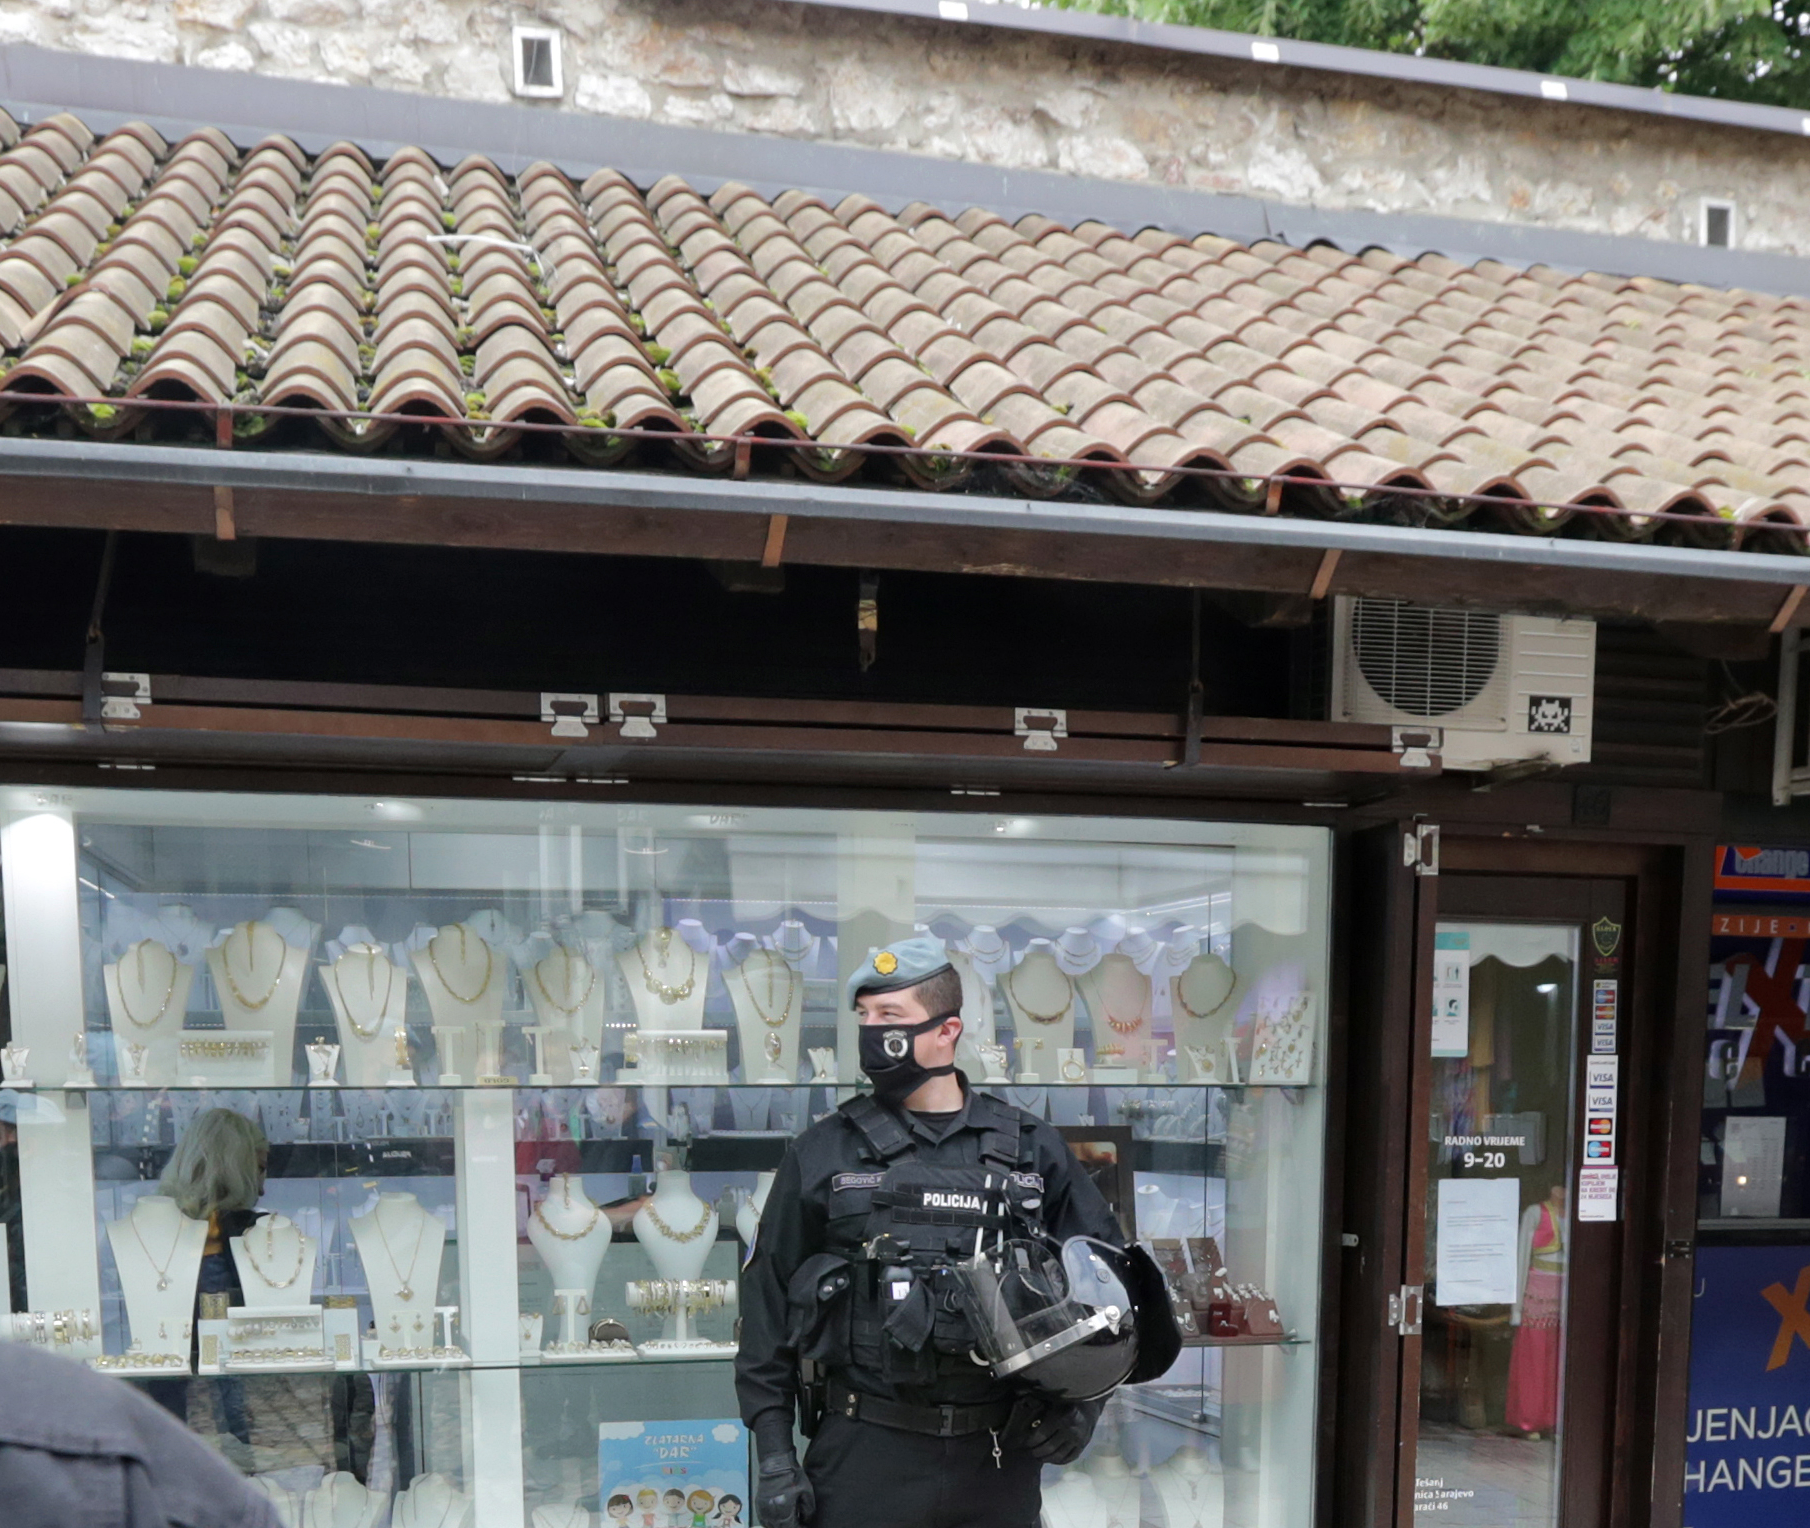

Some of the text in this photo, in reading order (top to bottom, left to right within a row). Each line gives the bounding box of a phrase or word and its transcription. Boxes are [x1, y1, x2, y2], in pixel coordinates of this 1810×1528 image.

[1720, 917, 1779, 935] ZIJE
[1593, 1073, 1614, 1082] VISA
[1592, 1097, 1613, 1106] VISA
[1444, 1135, 1526, 1147] RADNO VRIJEME
[1463, 1152, 1506, 1168] 9-20
[922, 1192, 981, 1210] POLICIJA
[645, 1434, 706, 1446] ZLATARNA
[1415, 1477, 1444, 1489] Tešanj
[1437, 1501, 1449, 1511] 46
